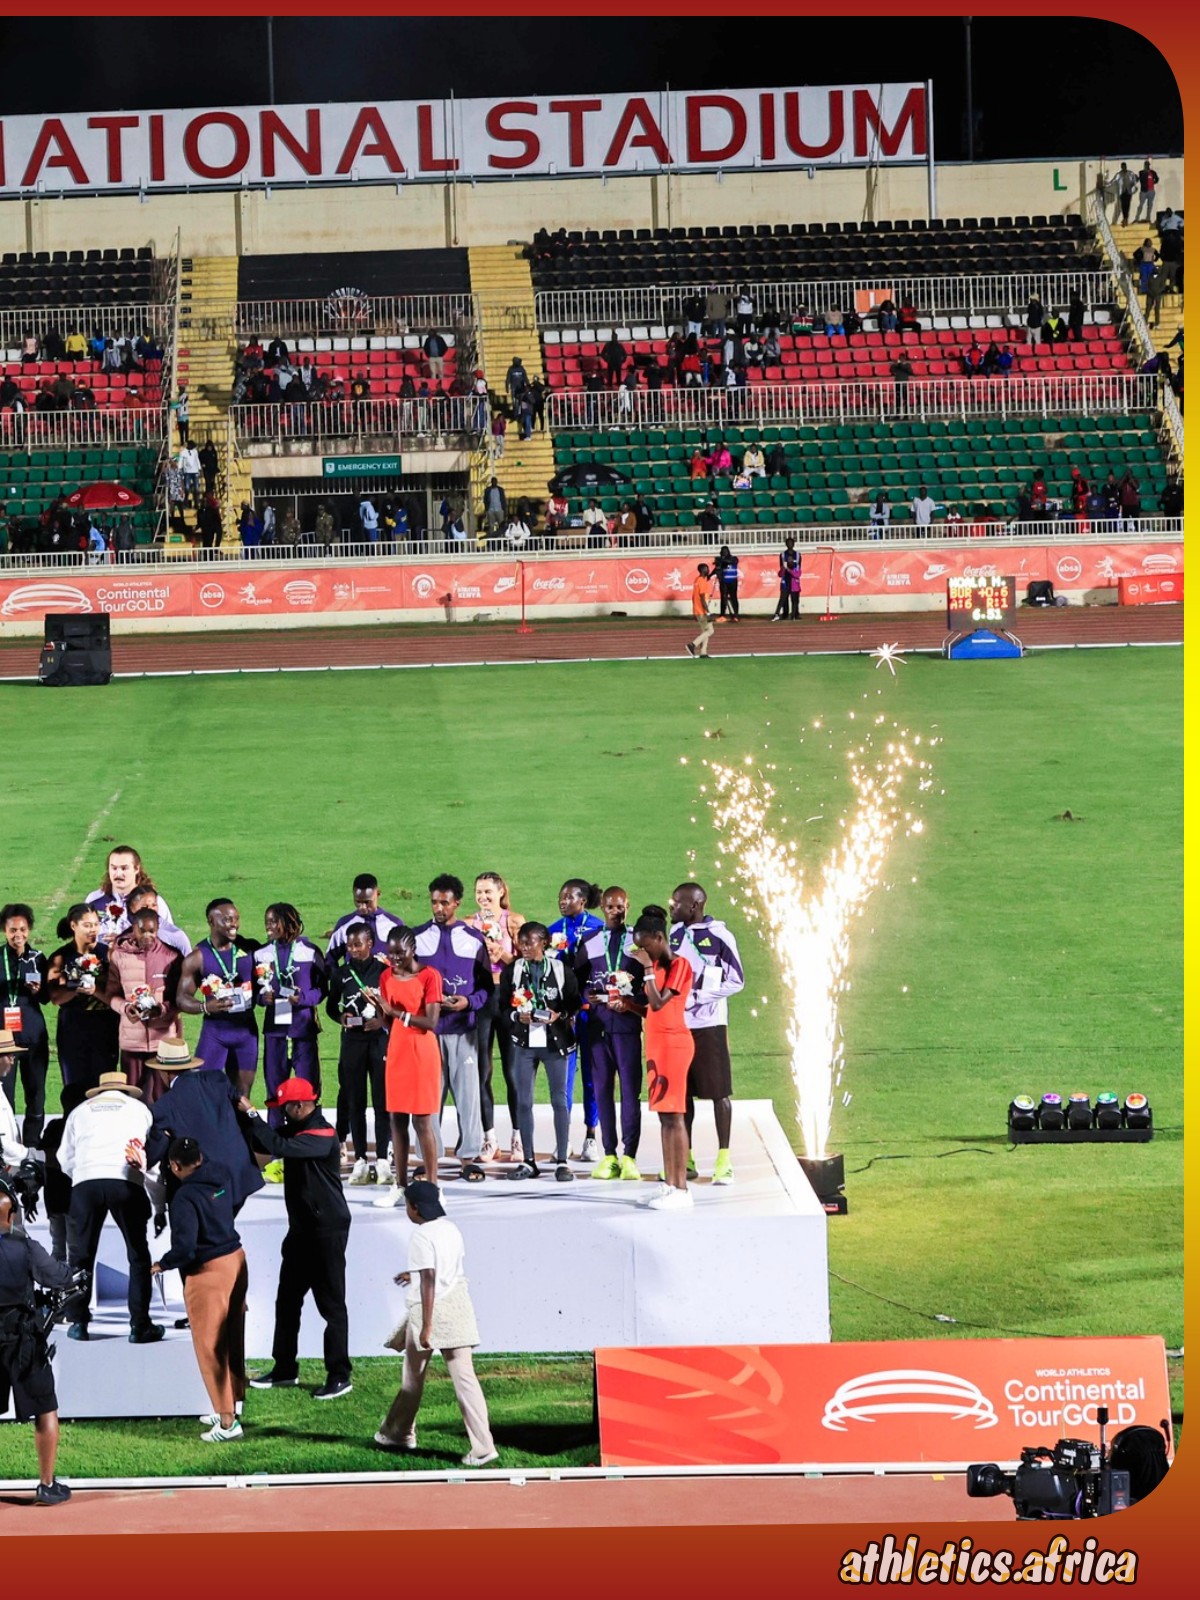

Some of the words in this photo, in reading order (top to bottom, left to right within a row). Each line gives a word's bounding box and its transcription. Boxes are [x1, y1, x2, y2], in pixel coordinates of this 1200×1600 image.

[485, 87, 928, 169] STADIUM
[1053, 168, 1068, 191] L
[337, 462, 381, 471] EMERGENCY
[382, 461, 398, 470] EXIT
[1058, 564, 1081, 573] absa
[627, 576, 649, 586] absa
[96, 586, 170, 600] Continental
[203, 591, 223, 599] absa
[950, 587, 972, 598] BUR
[978, 586, 1009, 598] +0.6
[949, 598, 973, 610] A:6
[986, 597, 1009, 608] R:1
[1035, 1368, 1066, 1377] WORLD
[1067, 1367, 1111, 1376] ATHLETICS
[1004, 1377, 1146, 1402] Continental
